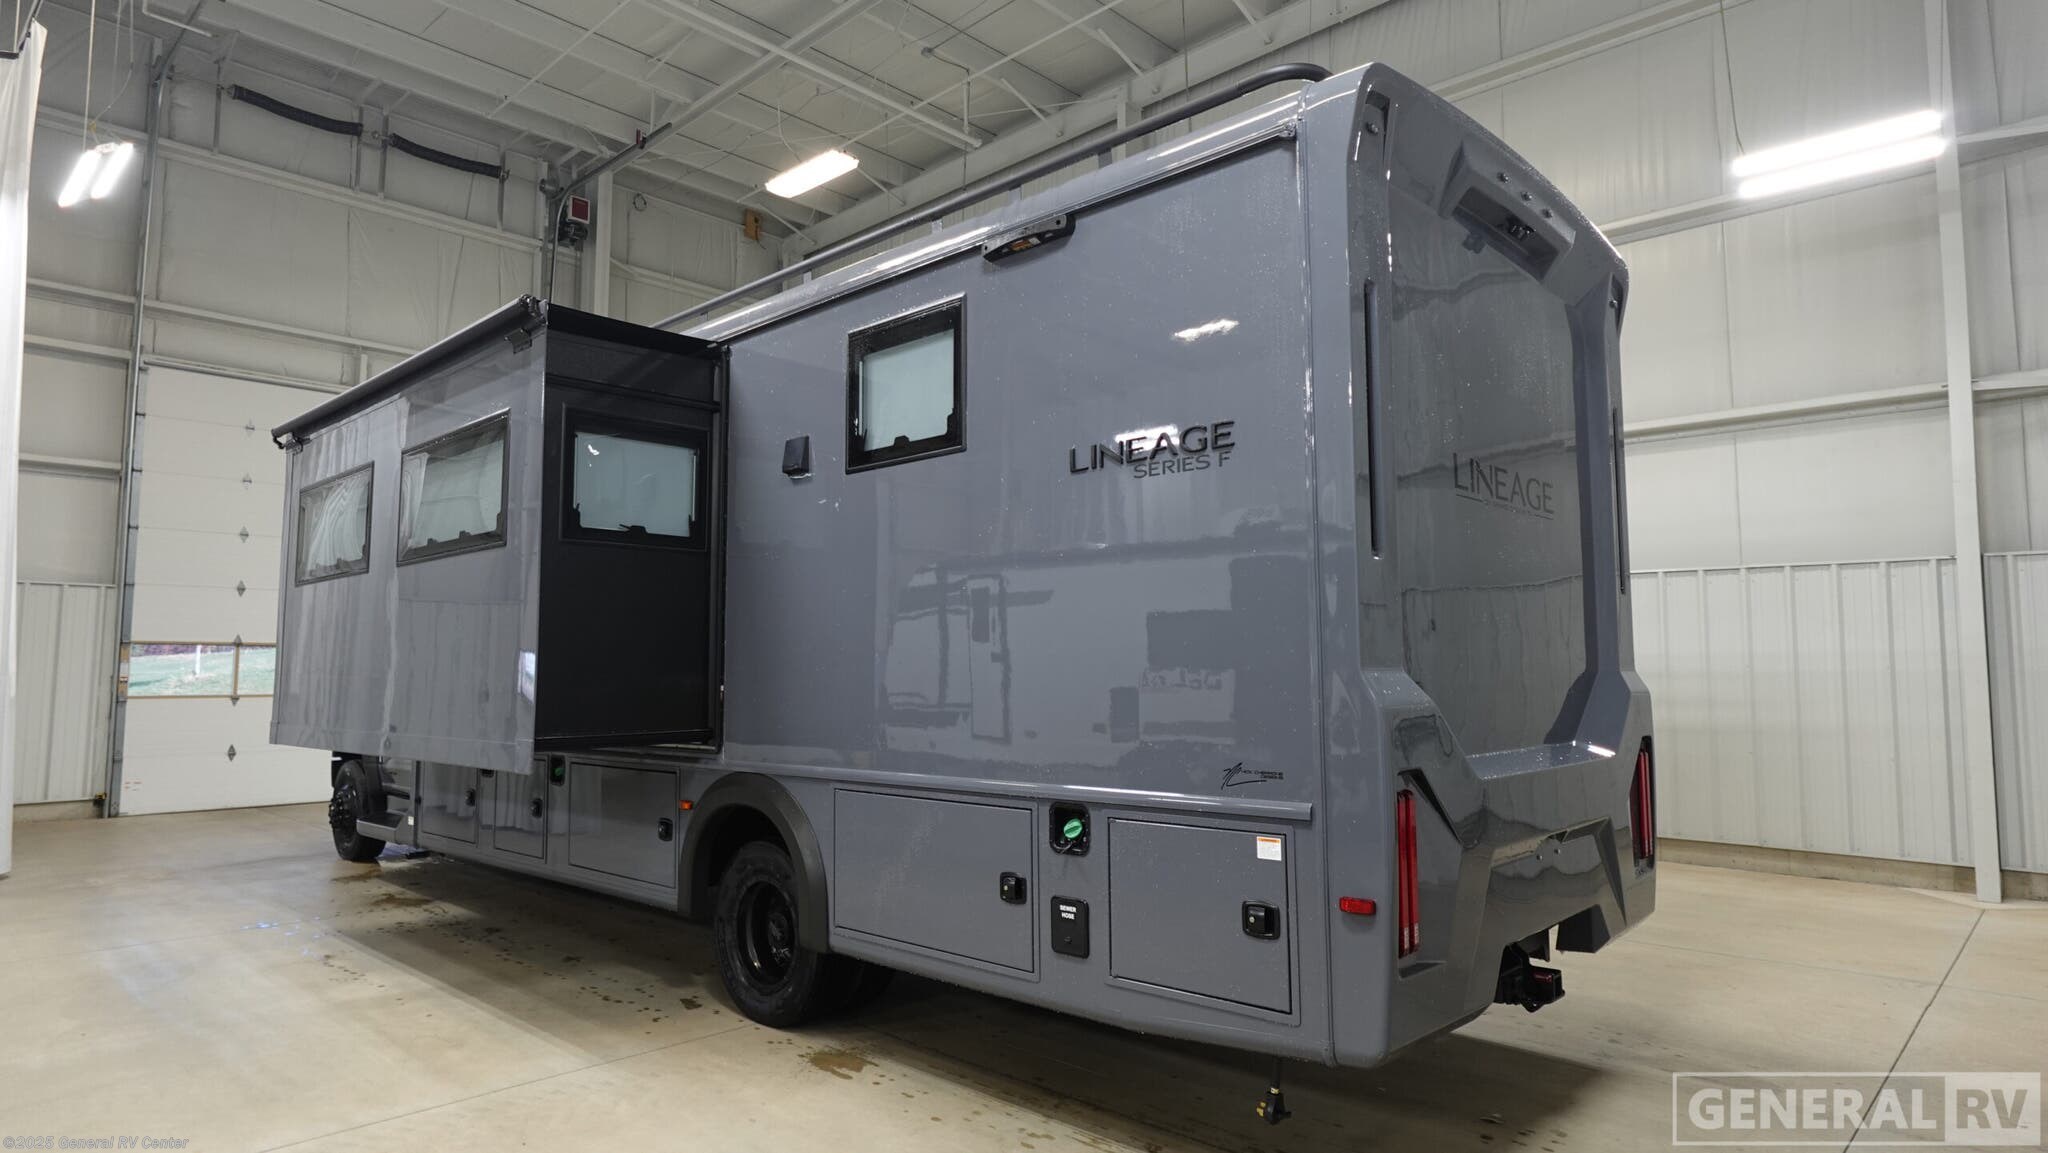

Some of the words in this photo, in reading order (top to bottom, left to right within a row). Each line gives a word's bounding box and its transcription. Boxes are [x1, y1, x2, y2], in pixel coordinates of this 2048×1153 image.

[1069, 421, 1236, 475] LINEAGE
[1133, 454, 1211, 479] SERIES
[1218, 450, 1232, 467] F
[1452, 452, 1555, 515] LINEAGE
